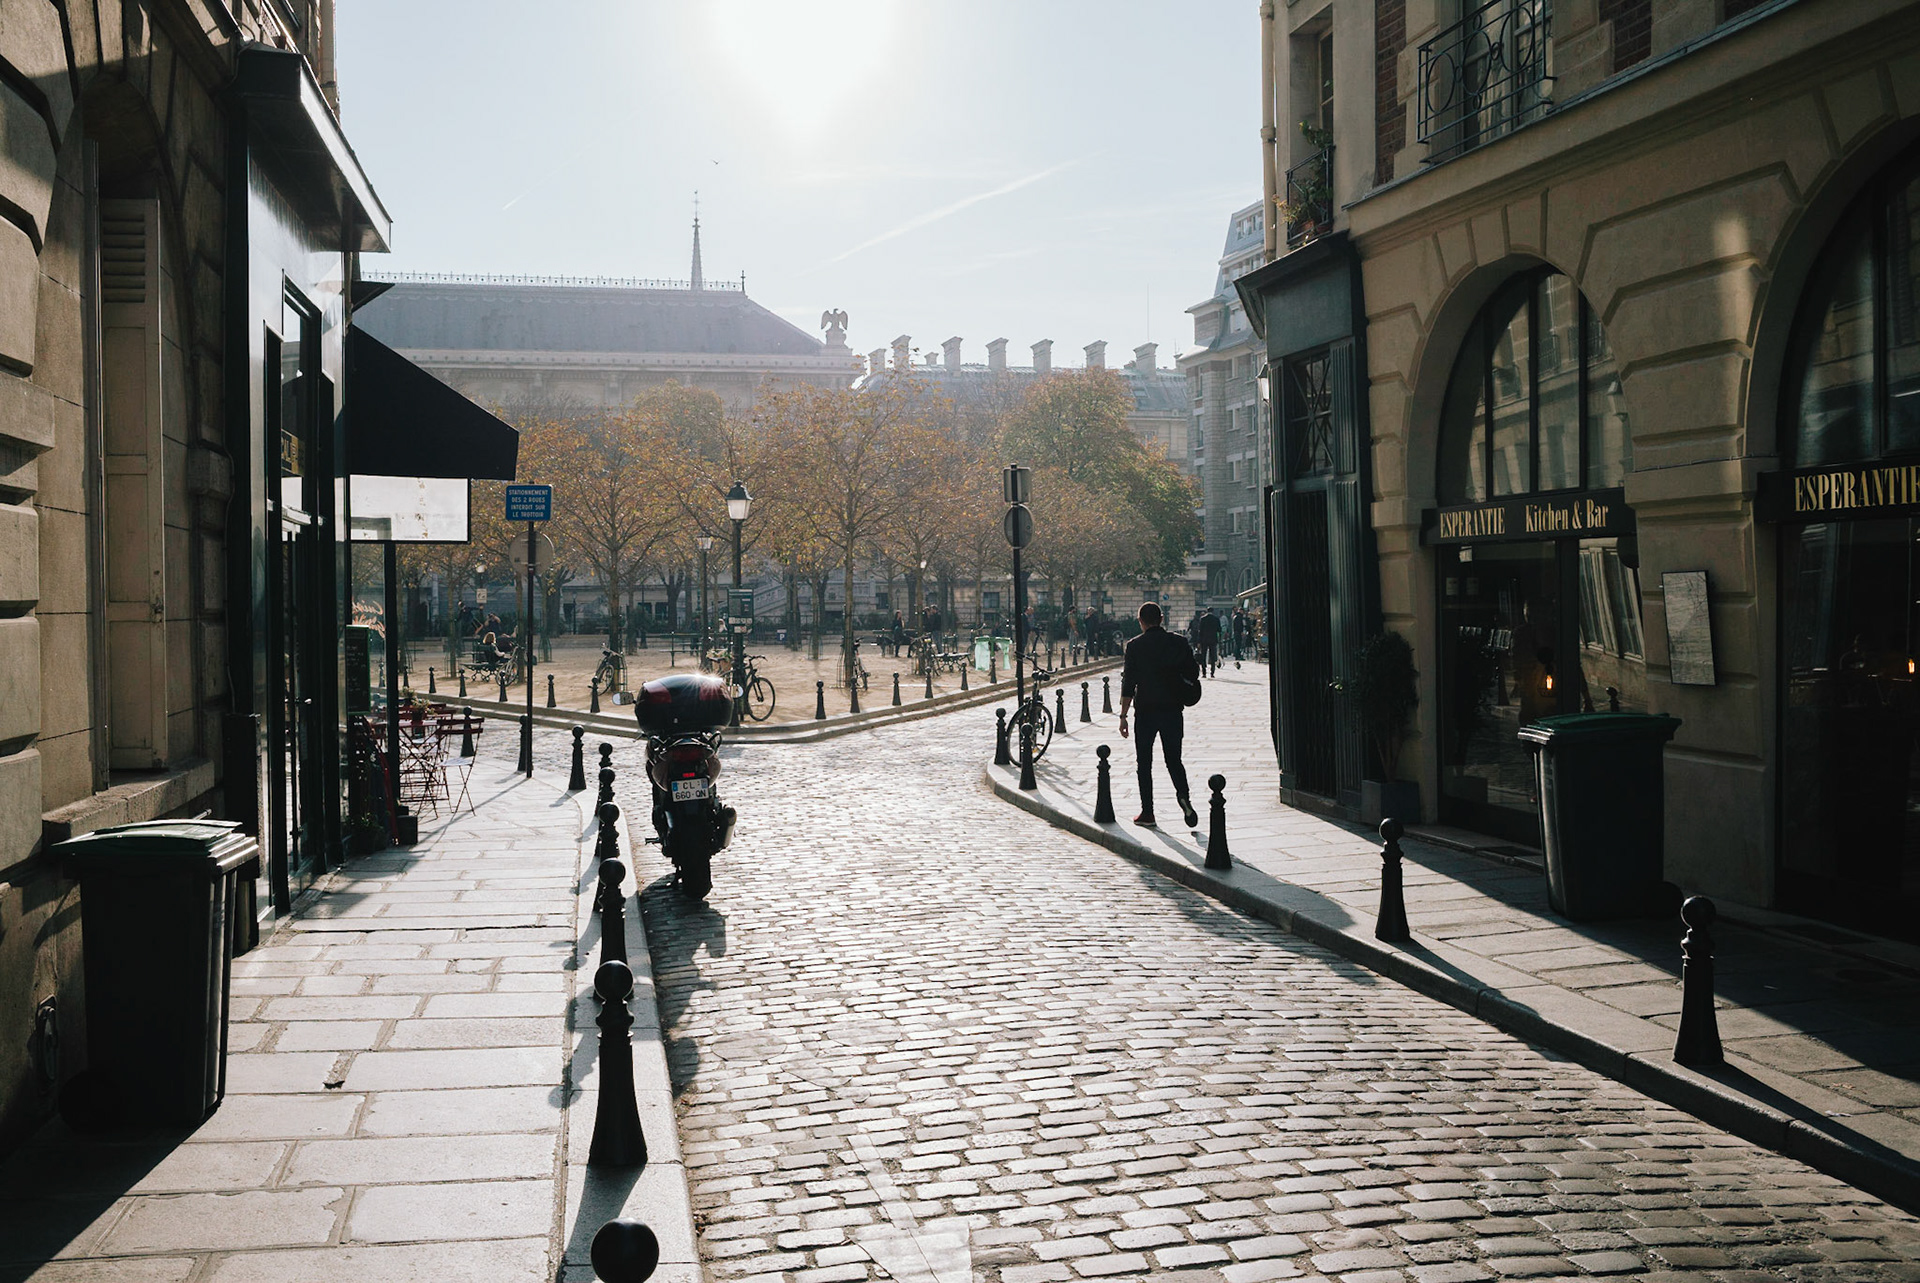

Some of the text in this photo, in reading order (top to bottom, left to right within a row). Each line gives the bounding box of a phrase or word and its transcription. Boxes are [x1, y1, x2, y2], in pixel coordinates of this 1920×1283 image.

[1440, 499, 1609, 538] ESPERANTIE Kitchen & Bar
